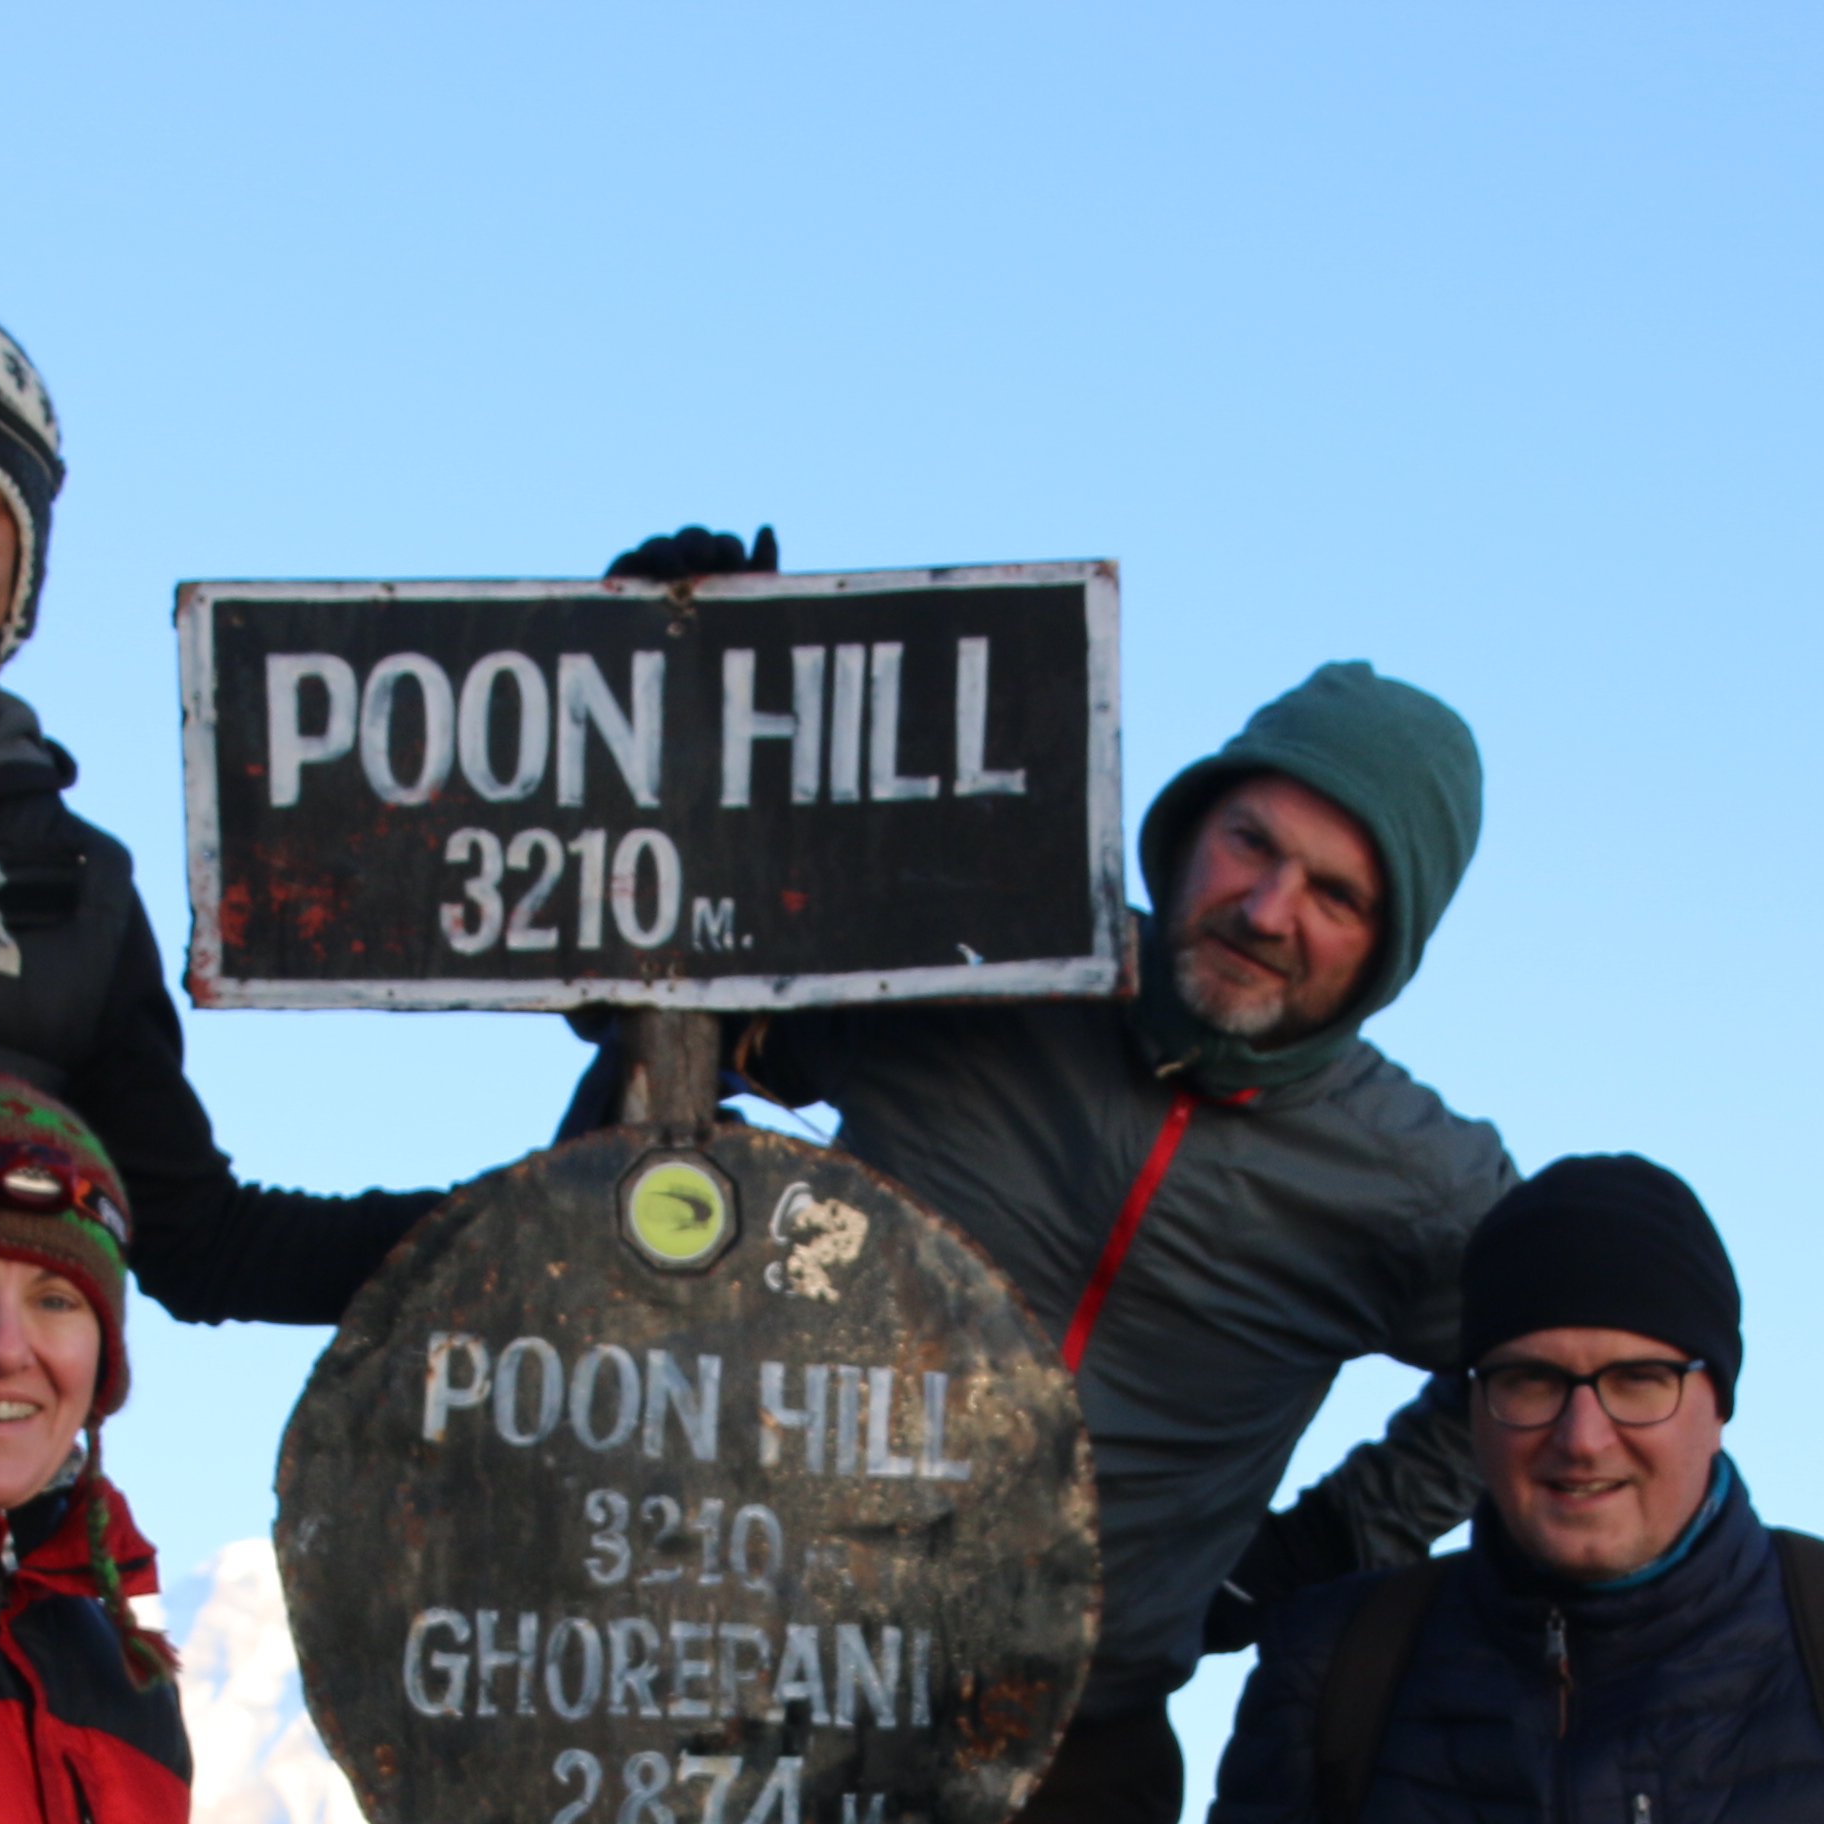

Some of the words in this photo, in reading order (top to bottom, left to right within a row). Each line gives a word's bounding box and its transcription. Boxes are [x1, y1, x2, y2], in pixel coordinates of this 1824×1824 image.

[266, 650, 664, 808] POON
[721, 636, 1027, 808] HILL
[422, 1332, 721, 1461] POON
[759, 1362, 973, 1480] HILL
[584, 1489, 783, 1592] 3210
[403, 1608, 931, 1729] GHOREPANI
